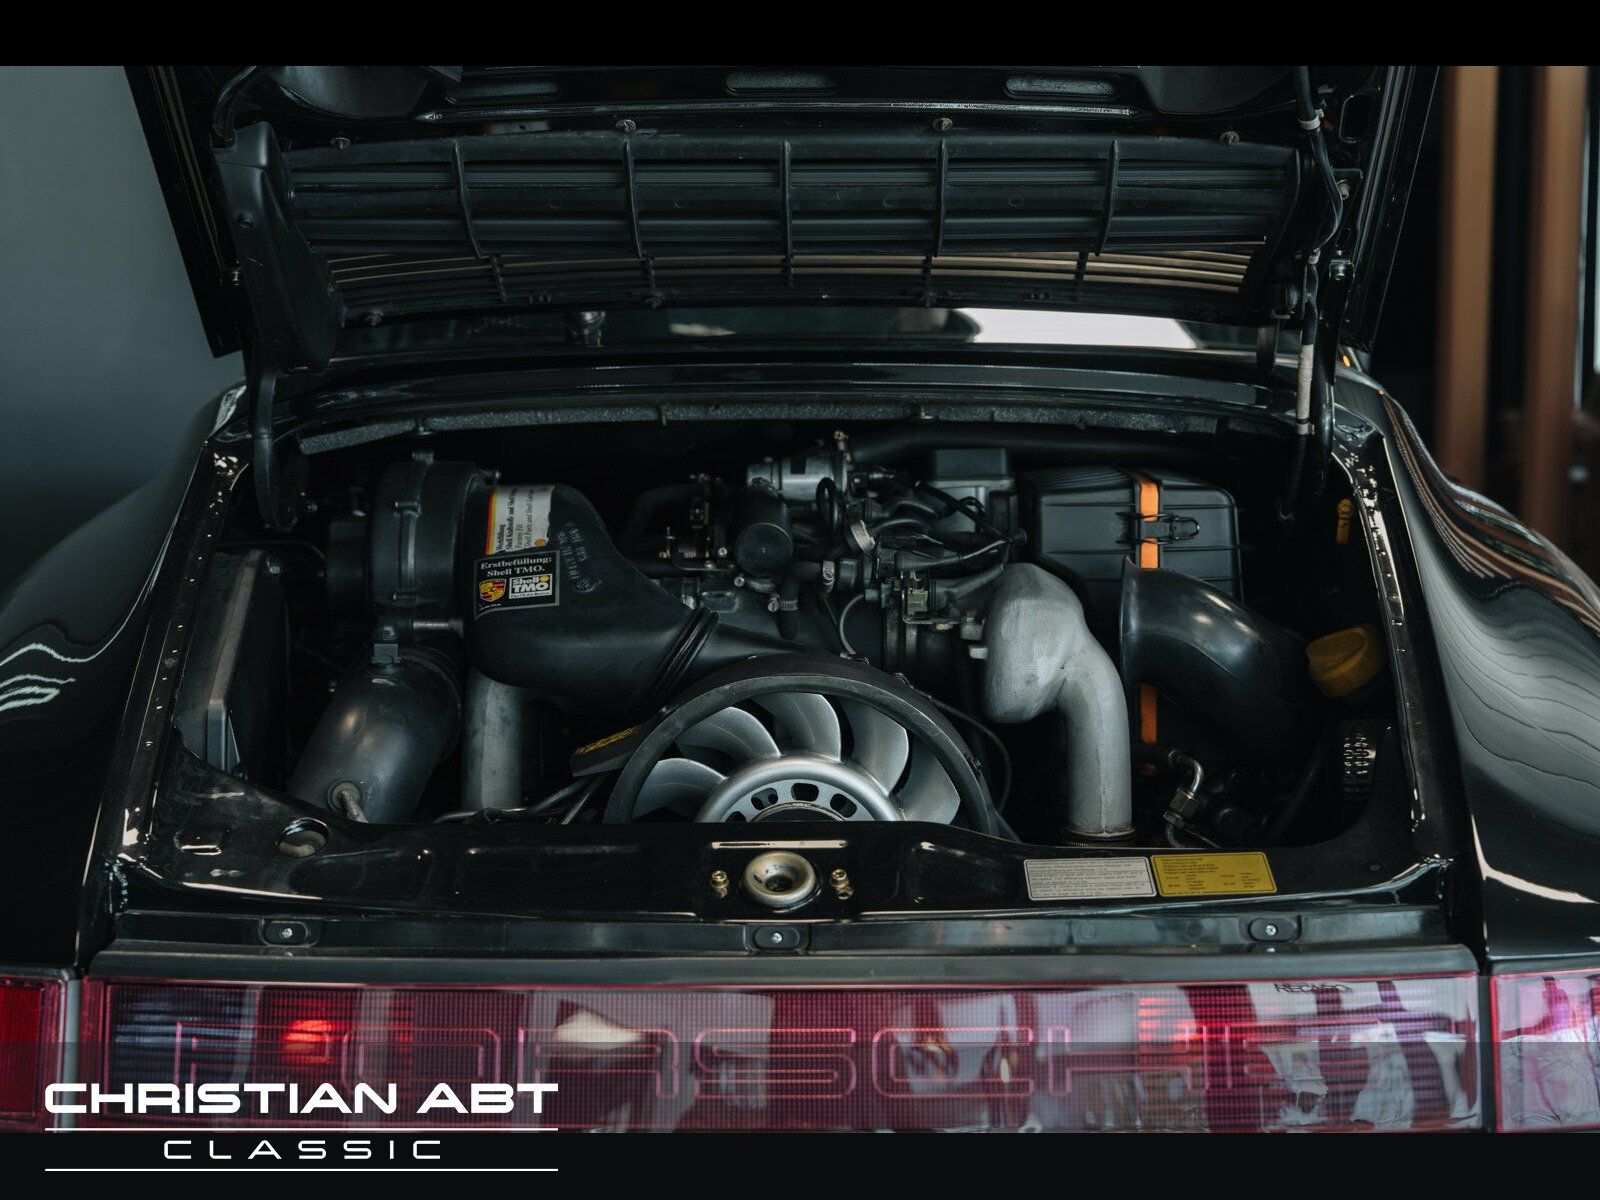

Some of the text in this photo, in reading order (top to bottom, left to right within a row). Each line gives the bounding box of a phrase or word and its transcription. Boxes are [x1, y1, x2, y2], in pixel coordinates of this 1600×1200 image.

[480, 556, 552, 570] Erstbefüllung:
[487, 565, 545, 577] Shell TMO.
[512, 576, 540, 585] Shell
[512, 582, 549, 593] TMO
